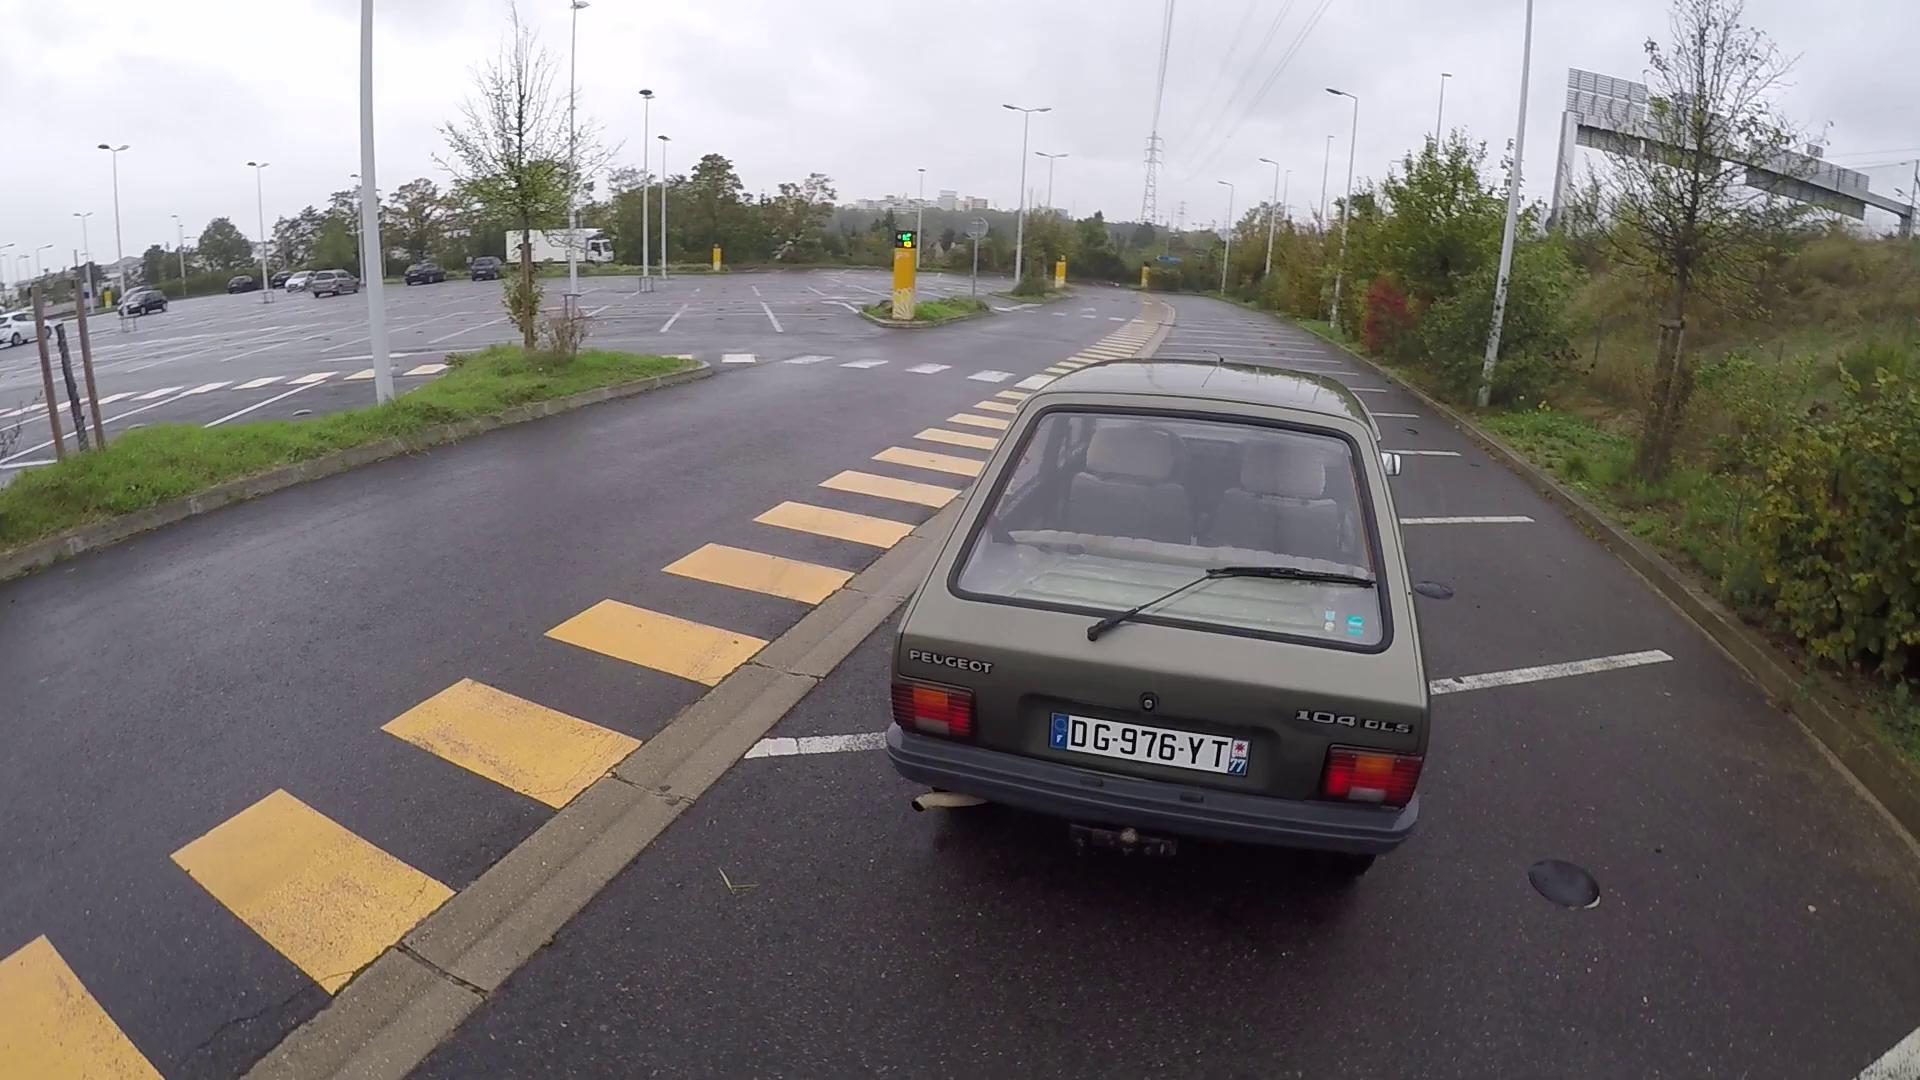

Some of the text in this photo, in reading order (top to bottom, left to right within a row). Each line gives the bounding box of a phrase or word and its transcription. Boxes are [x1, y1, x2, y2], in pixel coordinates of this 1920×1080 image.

[909, 649, 992, 673] PEUGEOT
[1296, 709, 1356, 727] 104
[1070, 719, 1229, 768] DG-976-YT
[1229, 758, 1246, 773] 77
